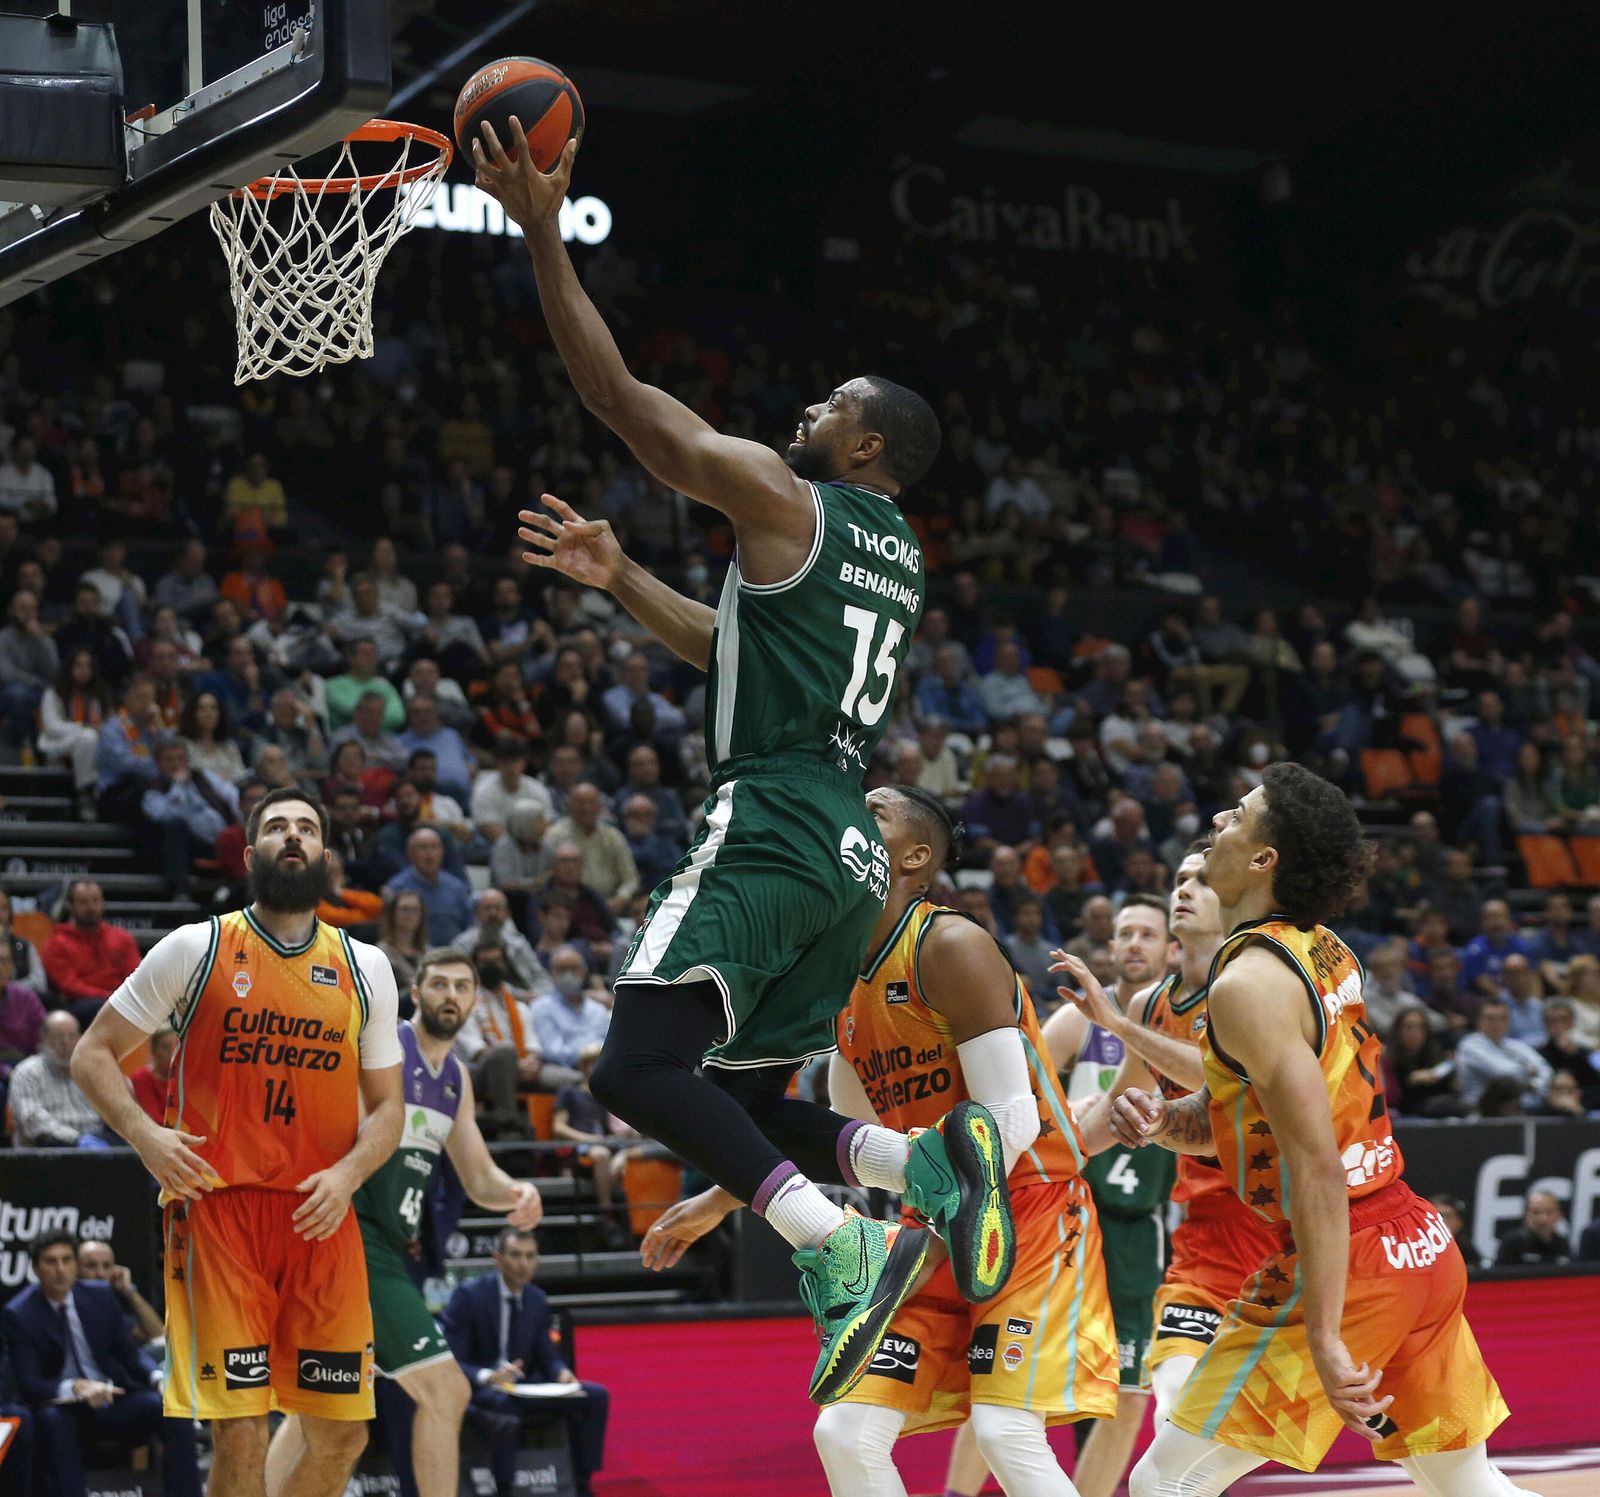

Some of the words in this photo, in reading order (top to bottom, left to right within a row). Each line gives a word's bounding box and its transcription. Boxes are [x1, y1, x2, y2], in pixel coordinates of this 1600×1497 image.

[264, 2, 286, 28] liga
[840, 604, 906, 726] 15
[223, 1007, 323, 1040] Cultura
[323, 1028, 346, 1044] del
[219, 1035, 341, 1072] Esfuerzo
[853, 1045, 912, 1085] Cultura
[916, 1044, 943, 1065] del
[263, 1078, 296, 1125] 14
[1106, 1153, 1139, 1195] 4
[79, 1215, 114, 1240] del
[879, 1338, 916, 1356] EVA
[1008, 1323, 1028, 1335] acb
[309, 1364, 360, 1383] Midea
